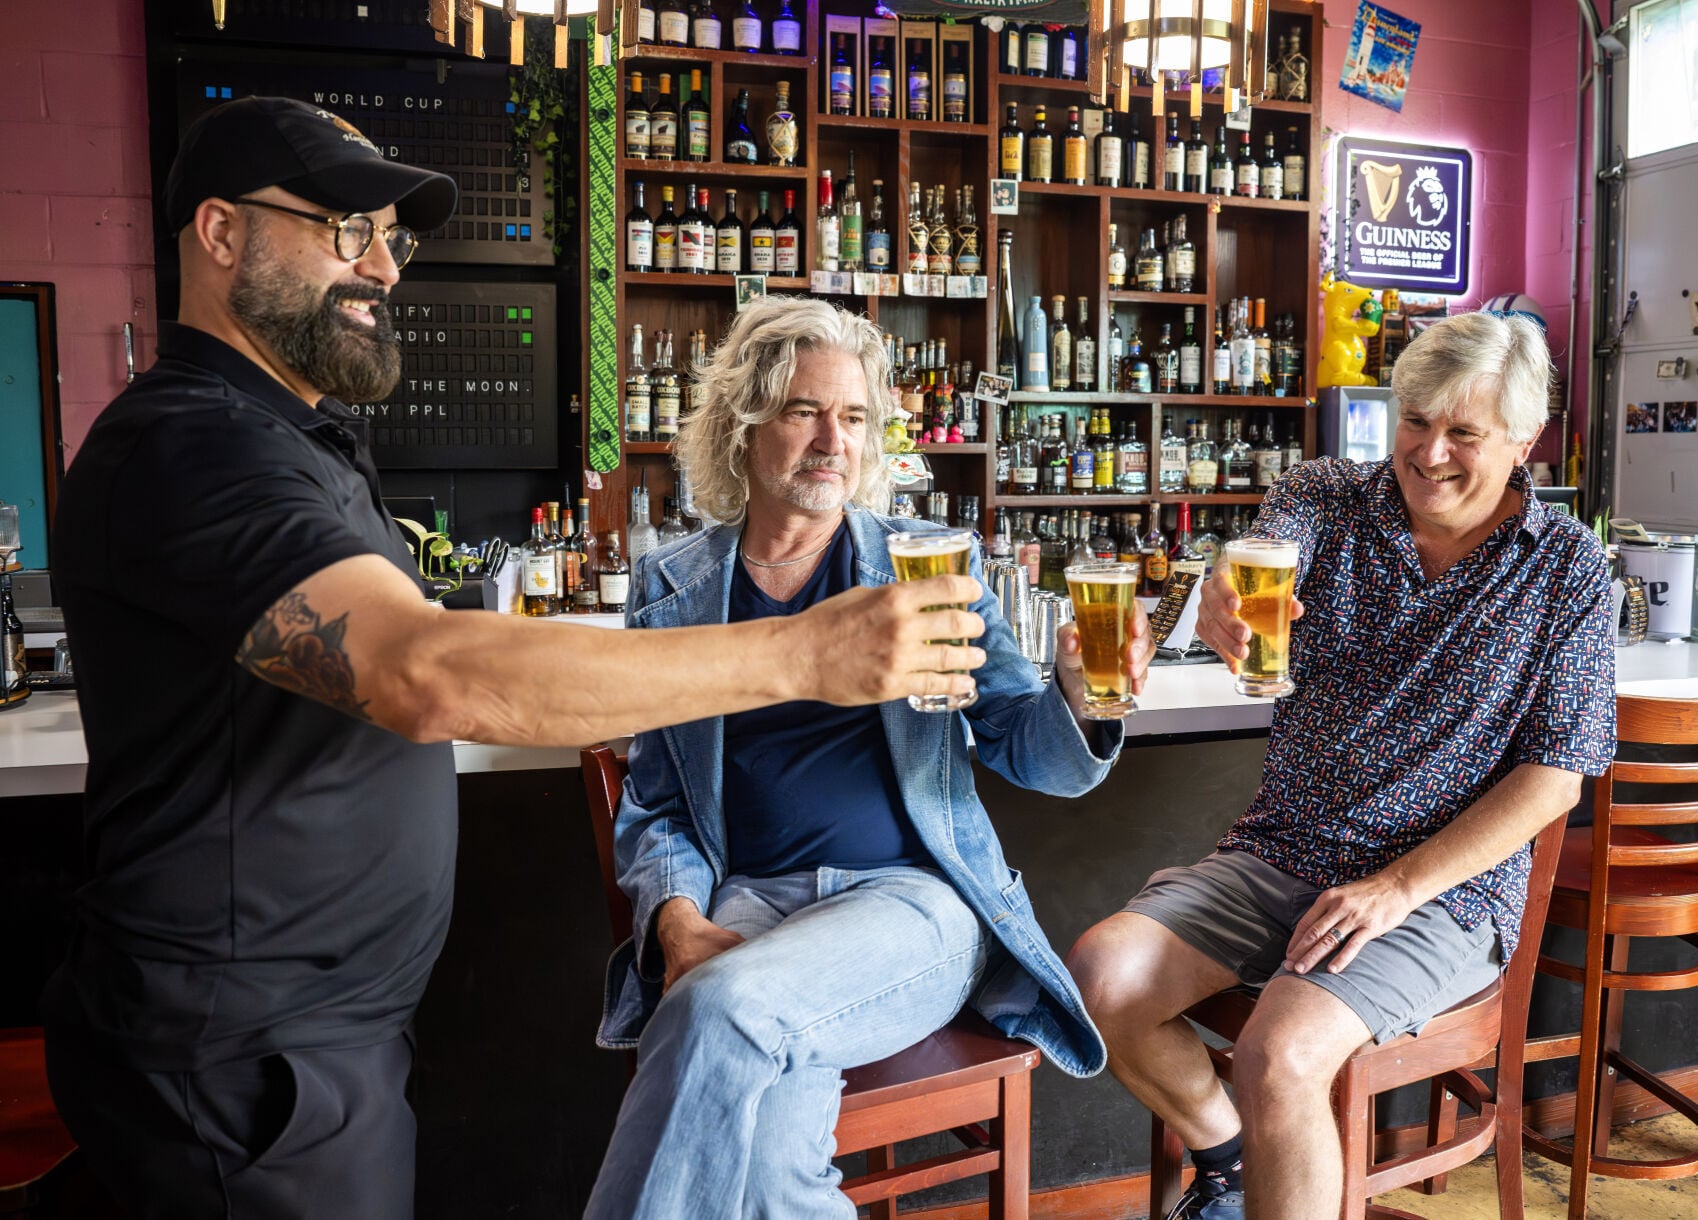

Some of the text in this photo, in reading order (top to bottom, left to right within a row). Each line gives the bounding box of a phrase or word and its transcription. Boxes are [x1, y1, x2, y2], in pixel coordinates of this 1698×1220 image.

[314, 92, 443, 110] WORLD CUP
[1355, 221, 1452, 251] GUINNESS
[1360, 247, 1444, 261] THE OFFICIAL BEER OF
[1361, 256, 1442, 270] THE PREMIER LEAGUE
[409, 380, 531, 392] THE MOON.
[409, 405, 447, 416] PPL
